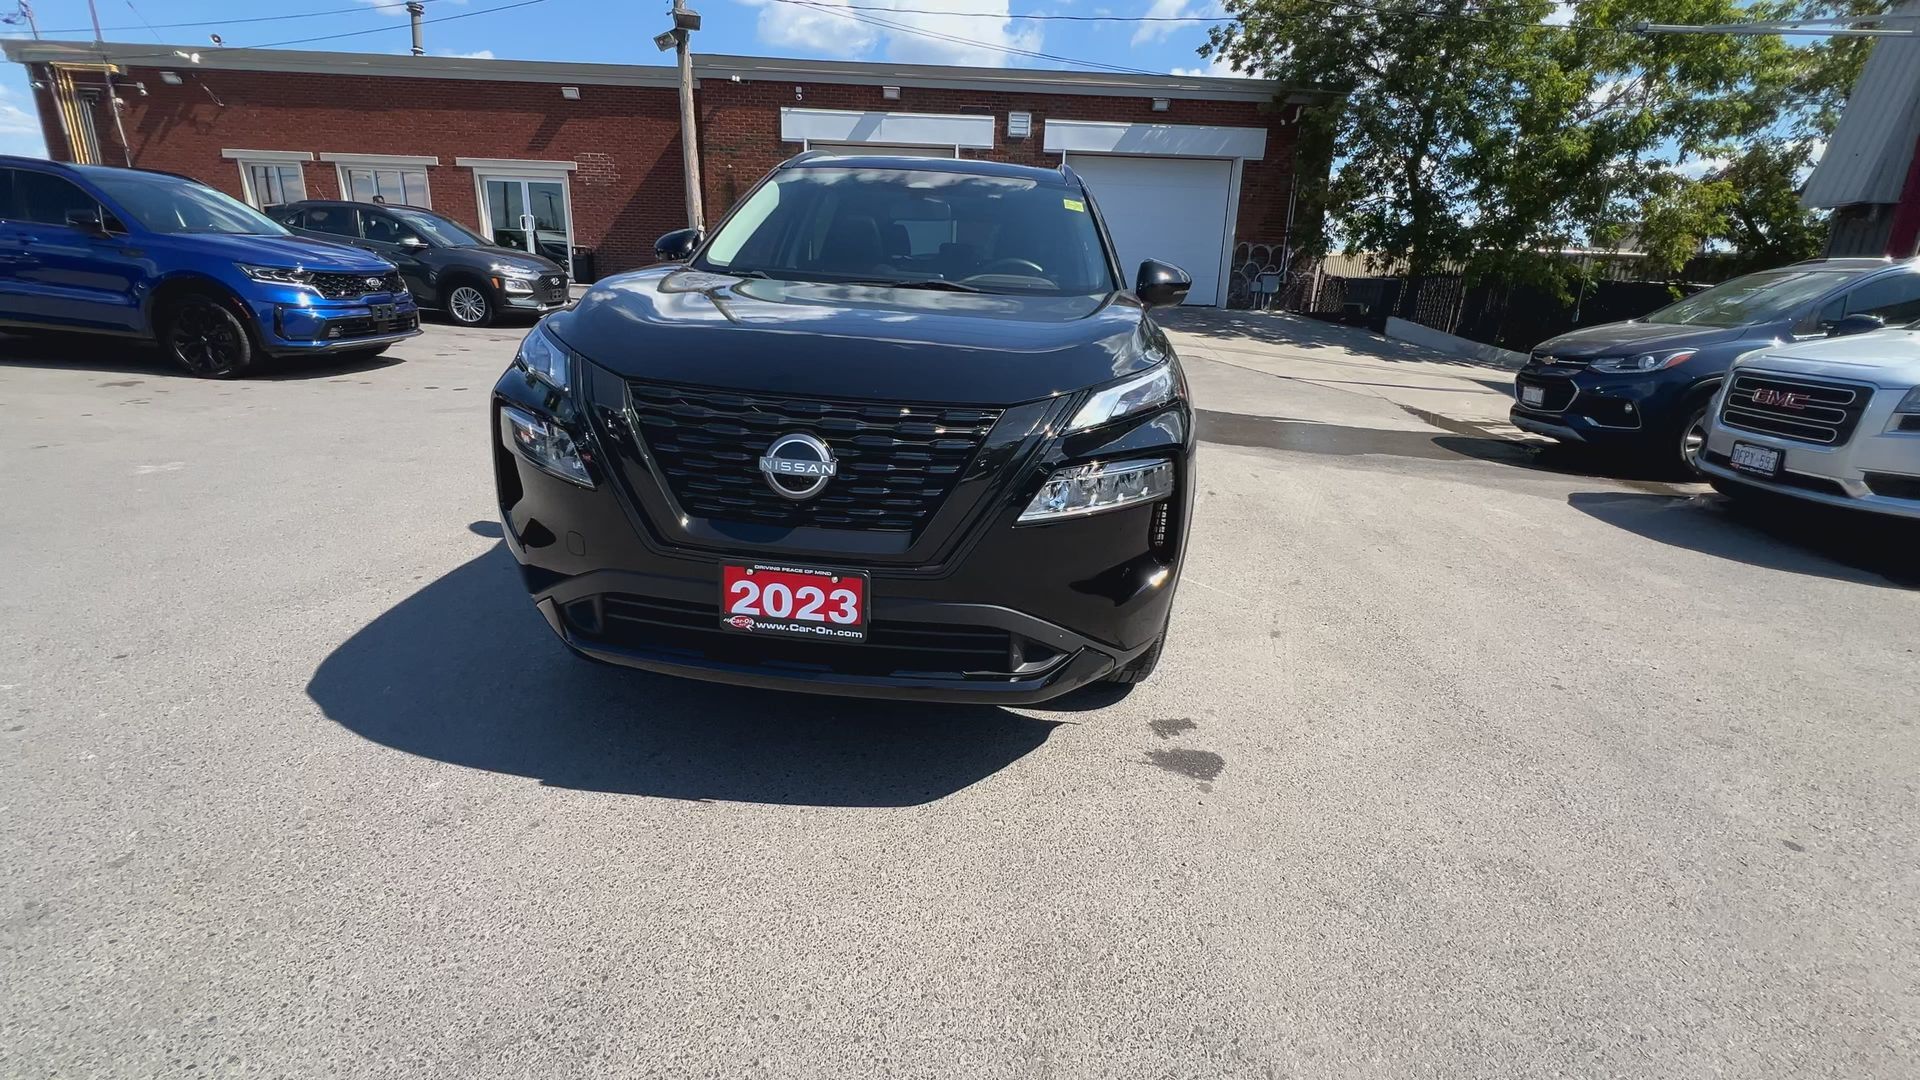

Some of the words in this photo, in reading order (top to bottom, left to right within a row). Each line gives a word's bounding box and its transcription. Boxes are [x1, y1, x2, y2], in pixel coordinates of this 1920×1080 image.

[1752, 389, 1811, 409] GMC
[761, 459, 834, 474] NISSAN
[754, 564, 781, 572] DRIVING
[730, 580, 858, 625] 2023
[756, 621, 863, 639] www.Car-On.com
